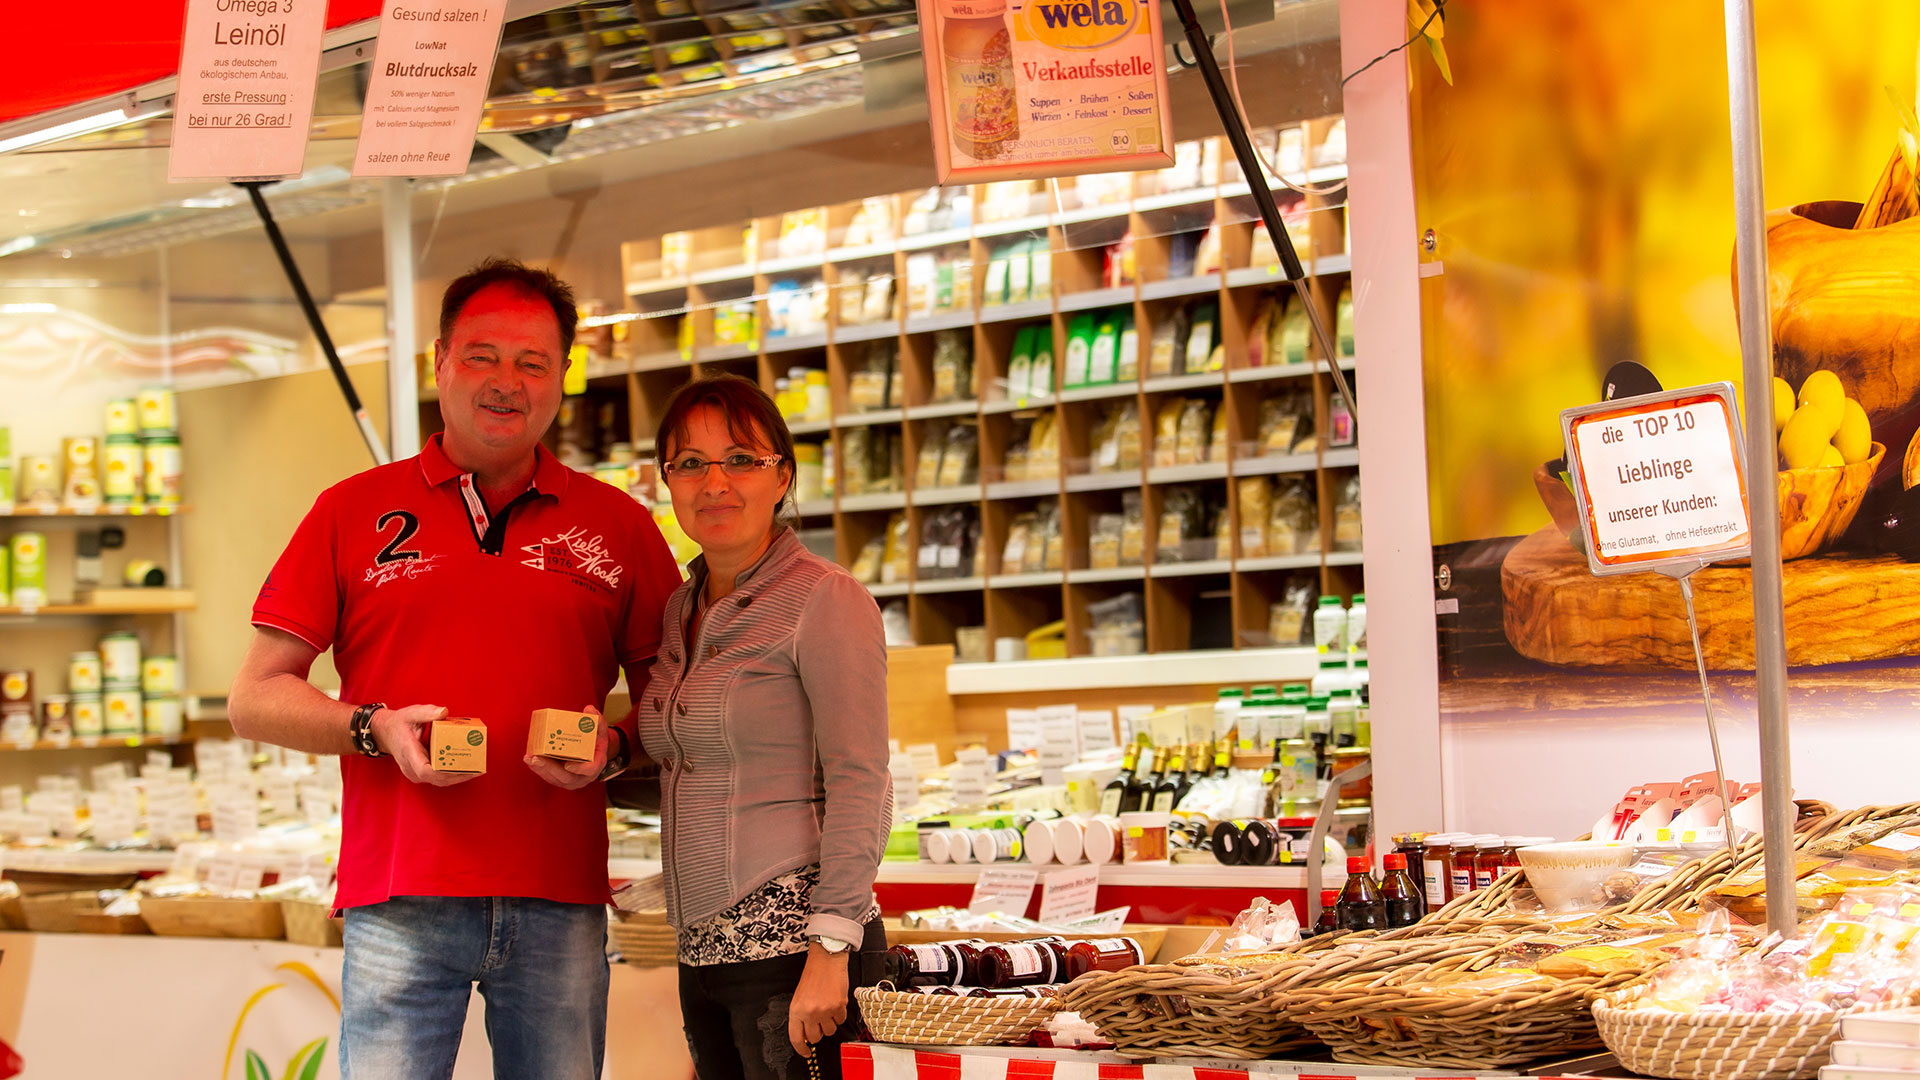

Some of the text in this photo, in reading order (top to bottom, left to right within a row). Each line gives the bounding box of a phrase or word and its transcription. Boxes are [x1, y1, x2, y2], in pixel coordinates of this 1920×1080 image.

[216, 0, 293, 17] Omega 3
[392, 7, 488, 23] Gesund salzen !
[952, 5, 973, 15] wela
[1035, 0, 1128, 28] wela
[214, 22, 286, 47] Leinöl
[415, 41, 447, 50] LowNat
[231, 58, 277, 67] deutschem
[385, 62, 477, 78] Blutdrucksalz
[1022, 56, 1153, 82] Verkaufsstelle
[200, 70, 258, 80] ökologischem
[961, 71, 997, 84] wela
[203, 93, 230, 103] erste
[235, 91, 286, 106] Pressung
[1030, 90, 1154, 108] Suppen Brühen Soßen
[426, 105, 460, 113] Magnesium
[1031, 105, 1152, 122] Würzen Feinkost Dessert
[188, 114, 208, 126] bei
[211, 115, 233, 126] nur
[235, 114, 251, 126] 26
[254, 114, 286, 126] Grad
[409, 120, 451, 129] Salzgeschmack
[1003, 136, 1095, 149] PERSÖNLICH BERATEN
[367, 151, 451, 164] salzen ohne Reue
[1034, 150, 1058, 159] immer
[1601, 410, 1696, 444] die TOP 10
[1617, 458, 1693, 484] Lieblinge
[1608, 494, 1718, 523] unserer Kunden:
[374, 509, 422, 568] 2
[541, 525, 610, 560] Kieler
[1596, 521, 1738, 551] ohne Glutamat, ohne Hefeextrakt
[550, 546, 571, 558] EST.
[547, 556, 573, 569] 1976
[574, 549, 623, 588] Woche
